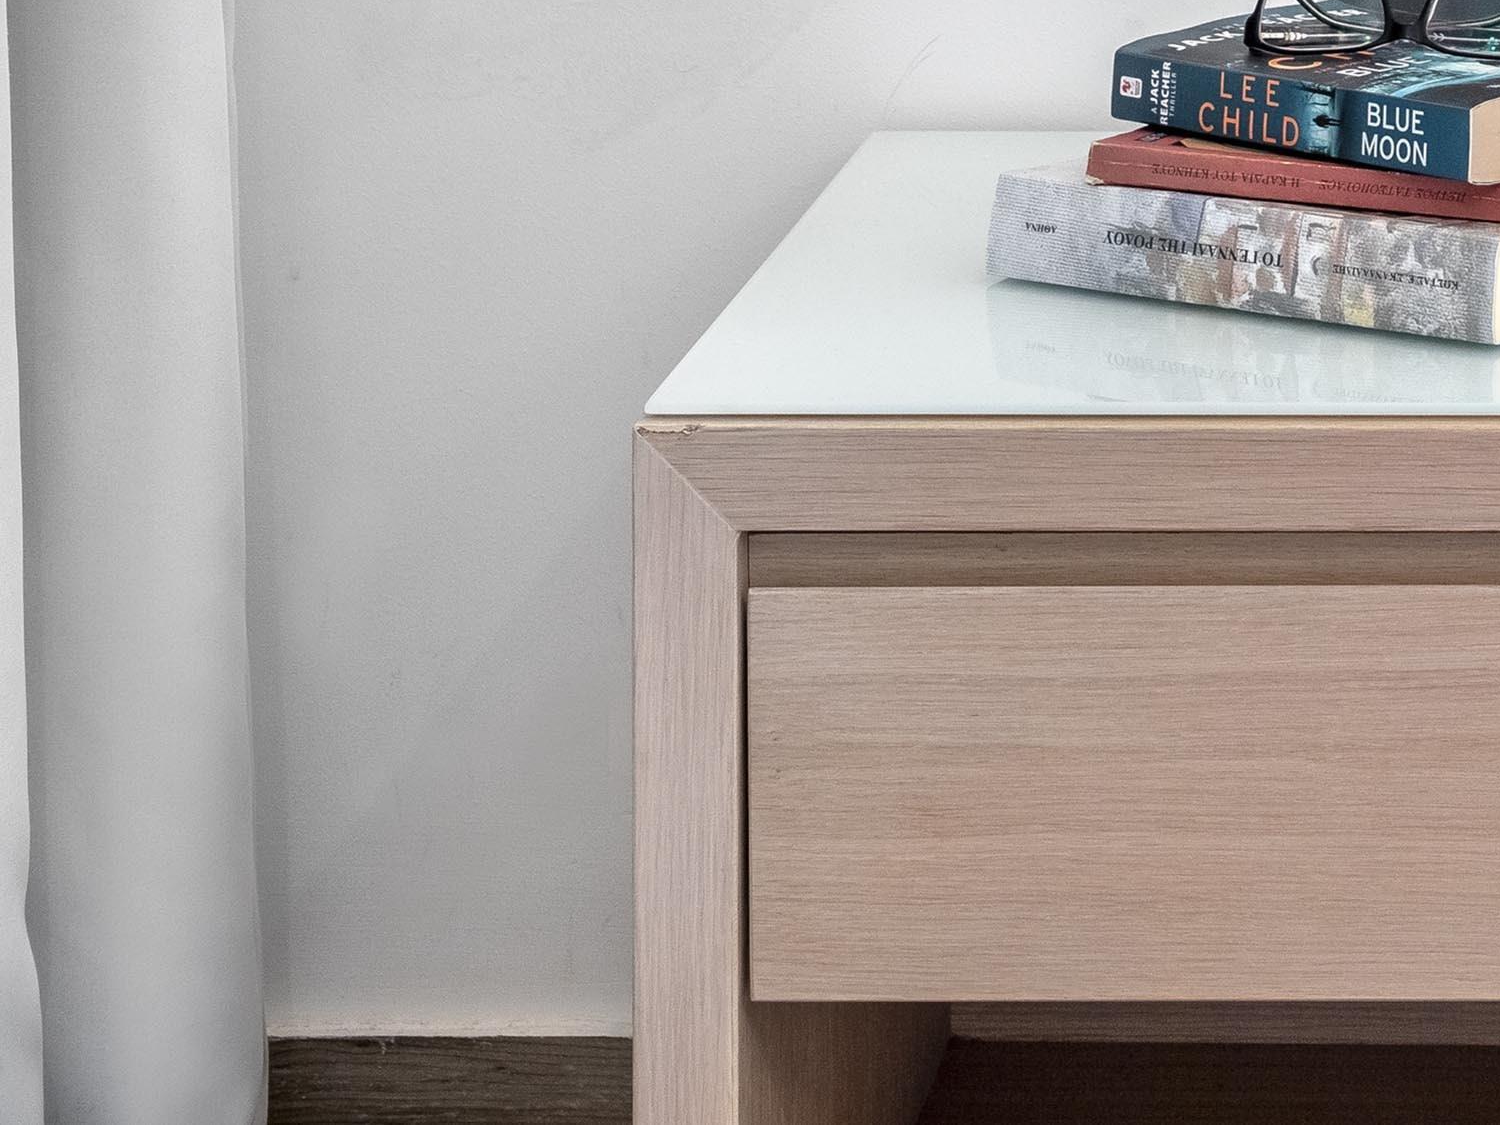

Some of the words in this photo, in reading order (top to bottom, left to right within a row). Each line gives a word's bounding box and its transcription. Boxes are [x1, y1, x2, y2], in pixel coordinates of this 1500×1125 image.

[1240, 8, 1369, 30] EACER
[1336, 57, 1432, 77] BLUE
[1150, 68, 1160, 105] JACK
[1159, 61, 1172, 126] REACHER
[1168, 72, 1178, 117] THRILLER
[1219, 71, 1281, 107] LEE
[1198, 102, 1300, 147] CHILD
[1366, 102, 1425, 136] BLUE
[1360, 131, 1428, 167] MOON
[1024, 221, 1058, 235] ΑΘΗΝΑ
[1103, 229, 1155, 250] ΡΟΔΟΥ
[1157, 237, 1188, 255] ΤΗΣ
[1191, 241, 1259, 264] ΓΕΝΝΑΔΙ
[1262, 251, 1284, 268] ΤΟ
